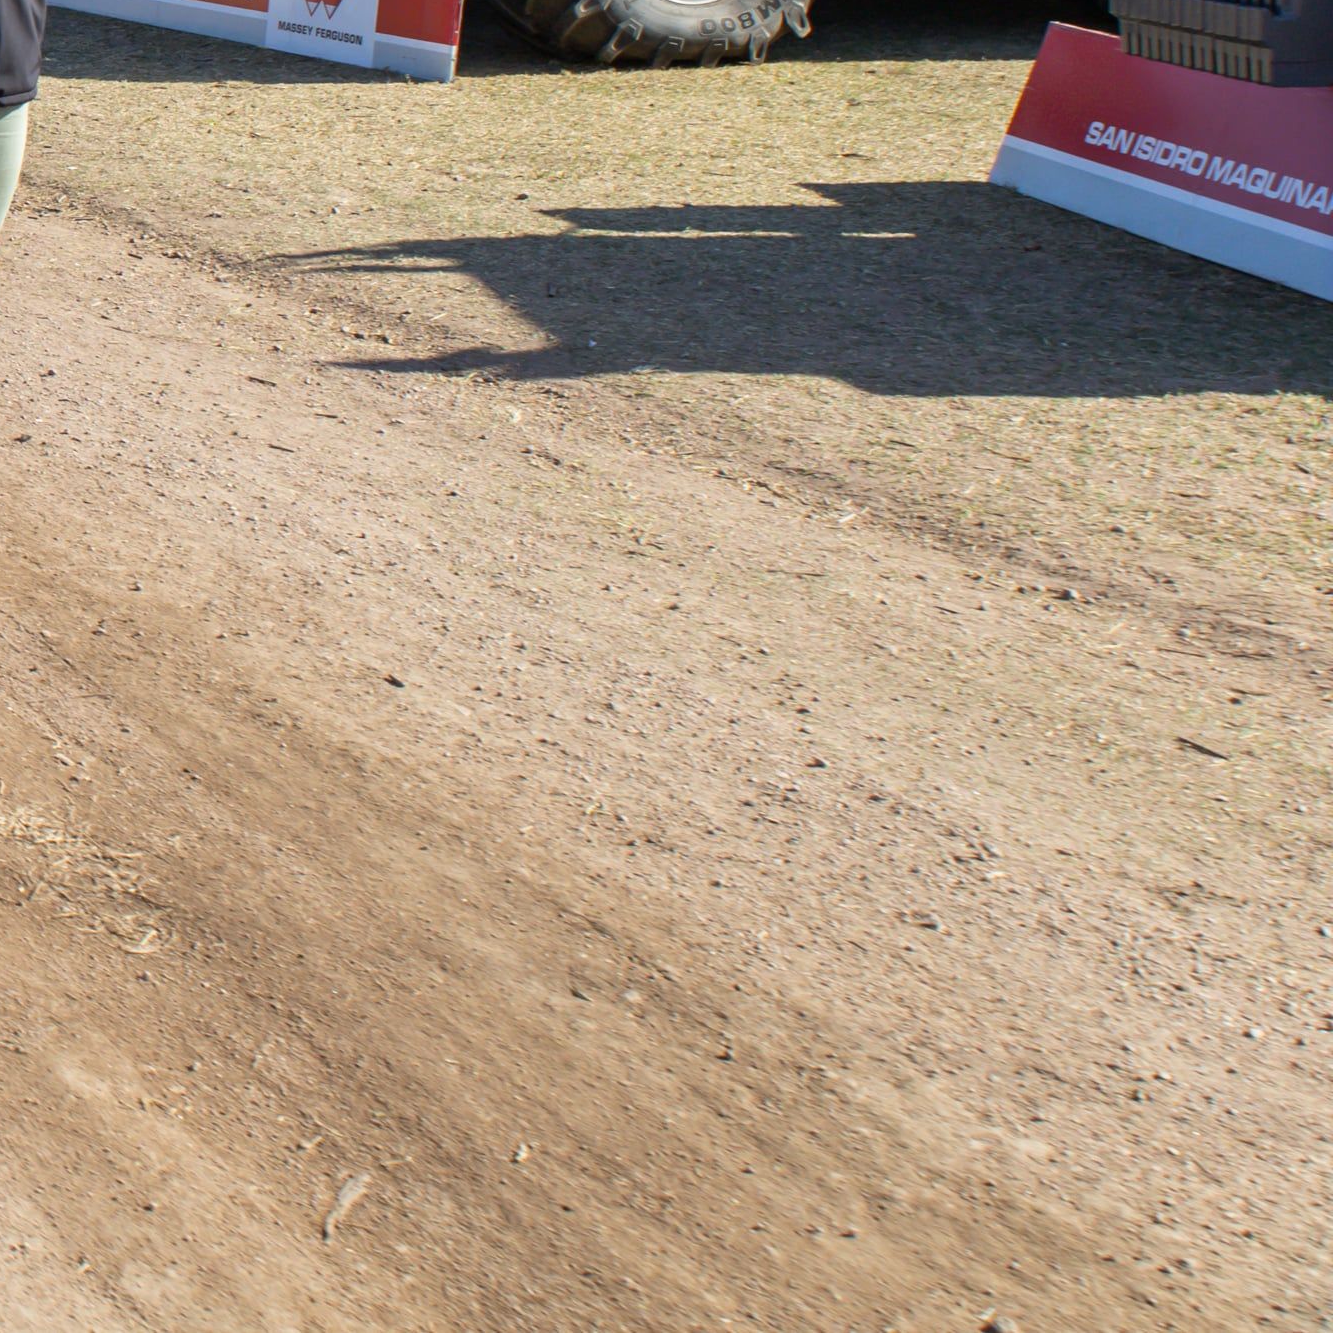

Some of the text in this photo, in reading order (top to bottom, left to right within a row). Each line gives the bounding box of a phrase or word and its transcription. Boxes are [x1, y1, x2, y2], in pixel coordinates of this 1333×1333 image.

[278, 20, 363, 46] MASSEY FERGUSON
[1084, 121, 1333, 215] SAN ISIDRO MAQUINA
